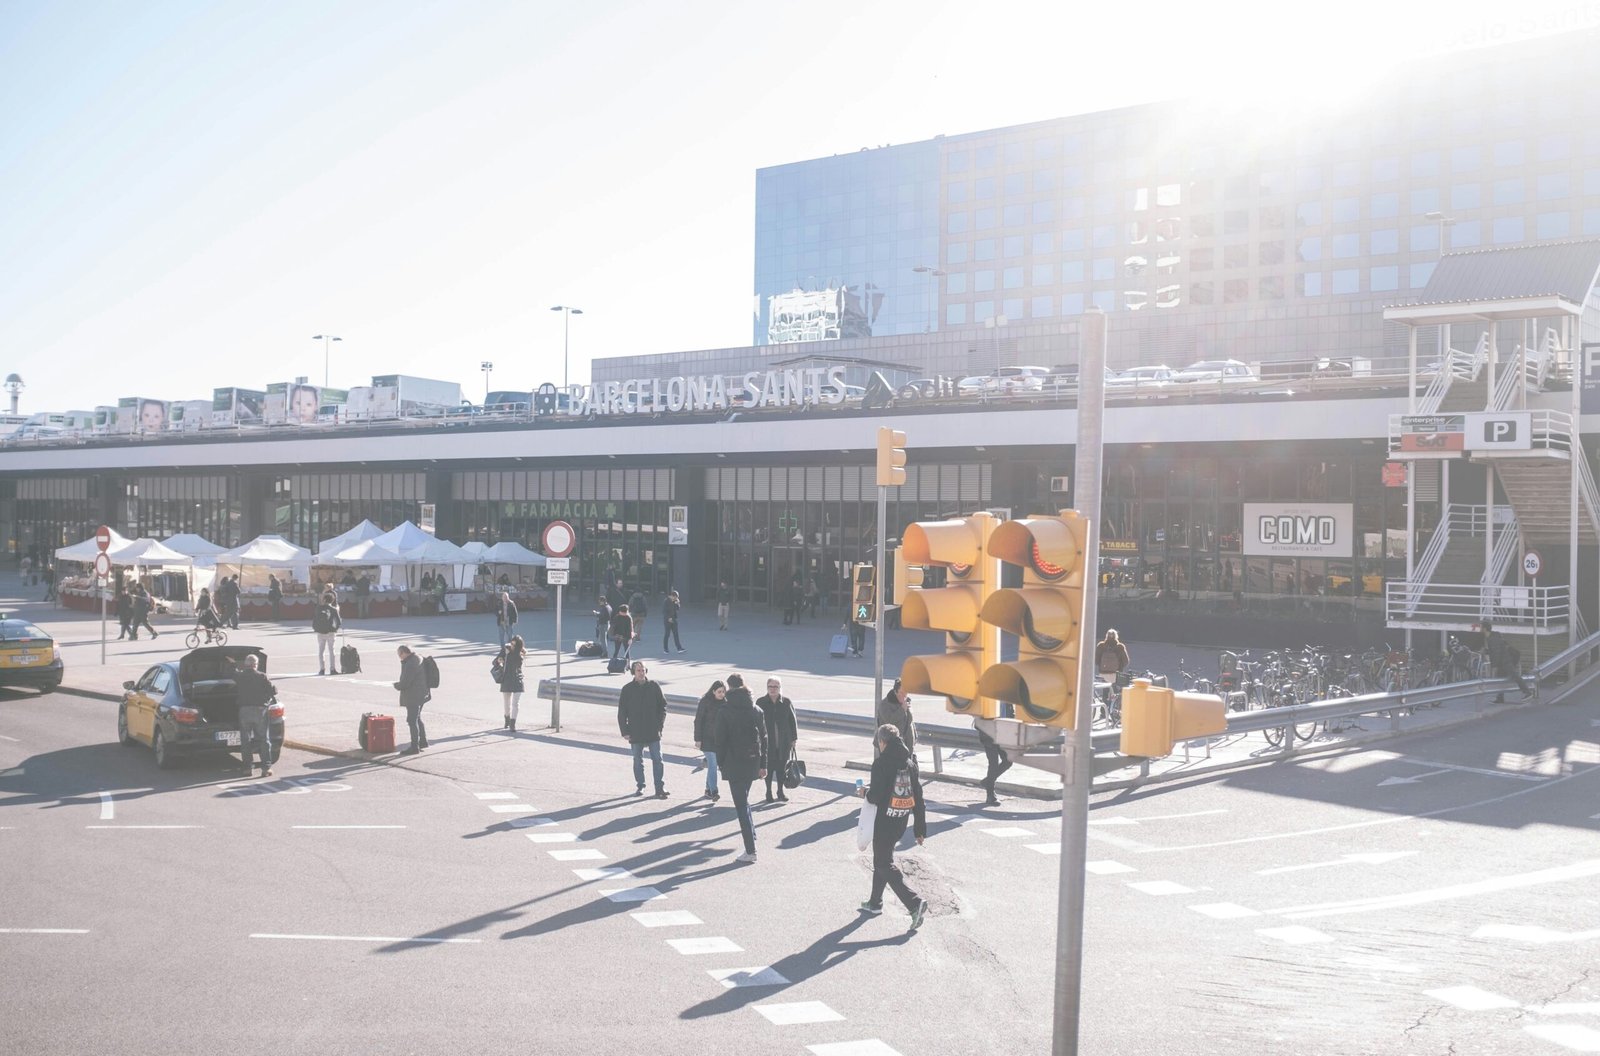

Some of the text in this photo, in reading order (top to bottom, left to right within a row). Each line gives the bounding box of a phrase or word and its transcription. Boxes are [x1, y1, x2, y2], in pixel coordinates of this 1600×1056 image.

[1403, 416, 1446, 425] enterprise
[1493, 422, 1510, 442] P
[1258, 515, 1336, 545] COMO
